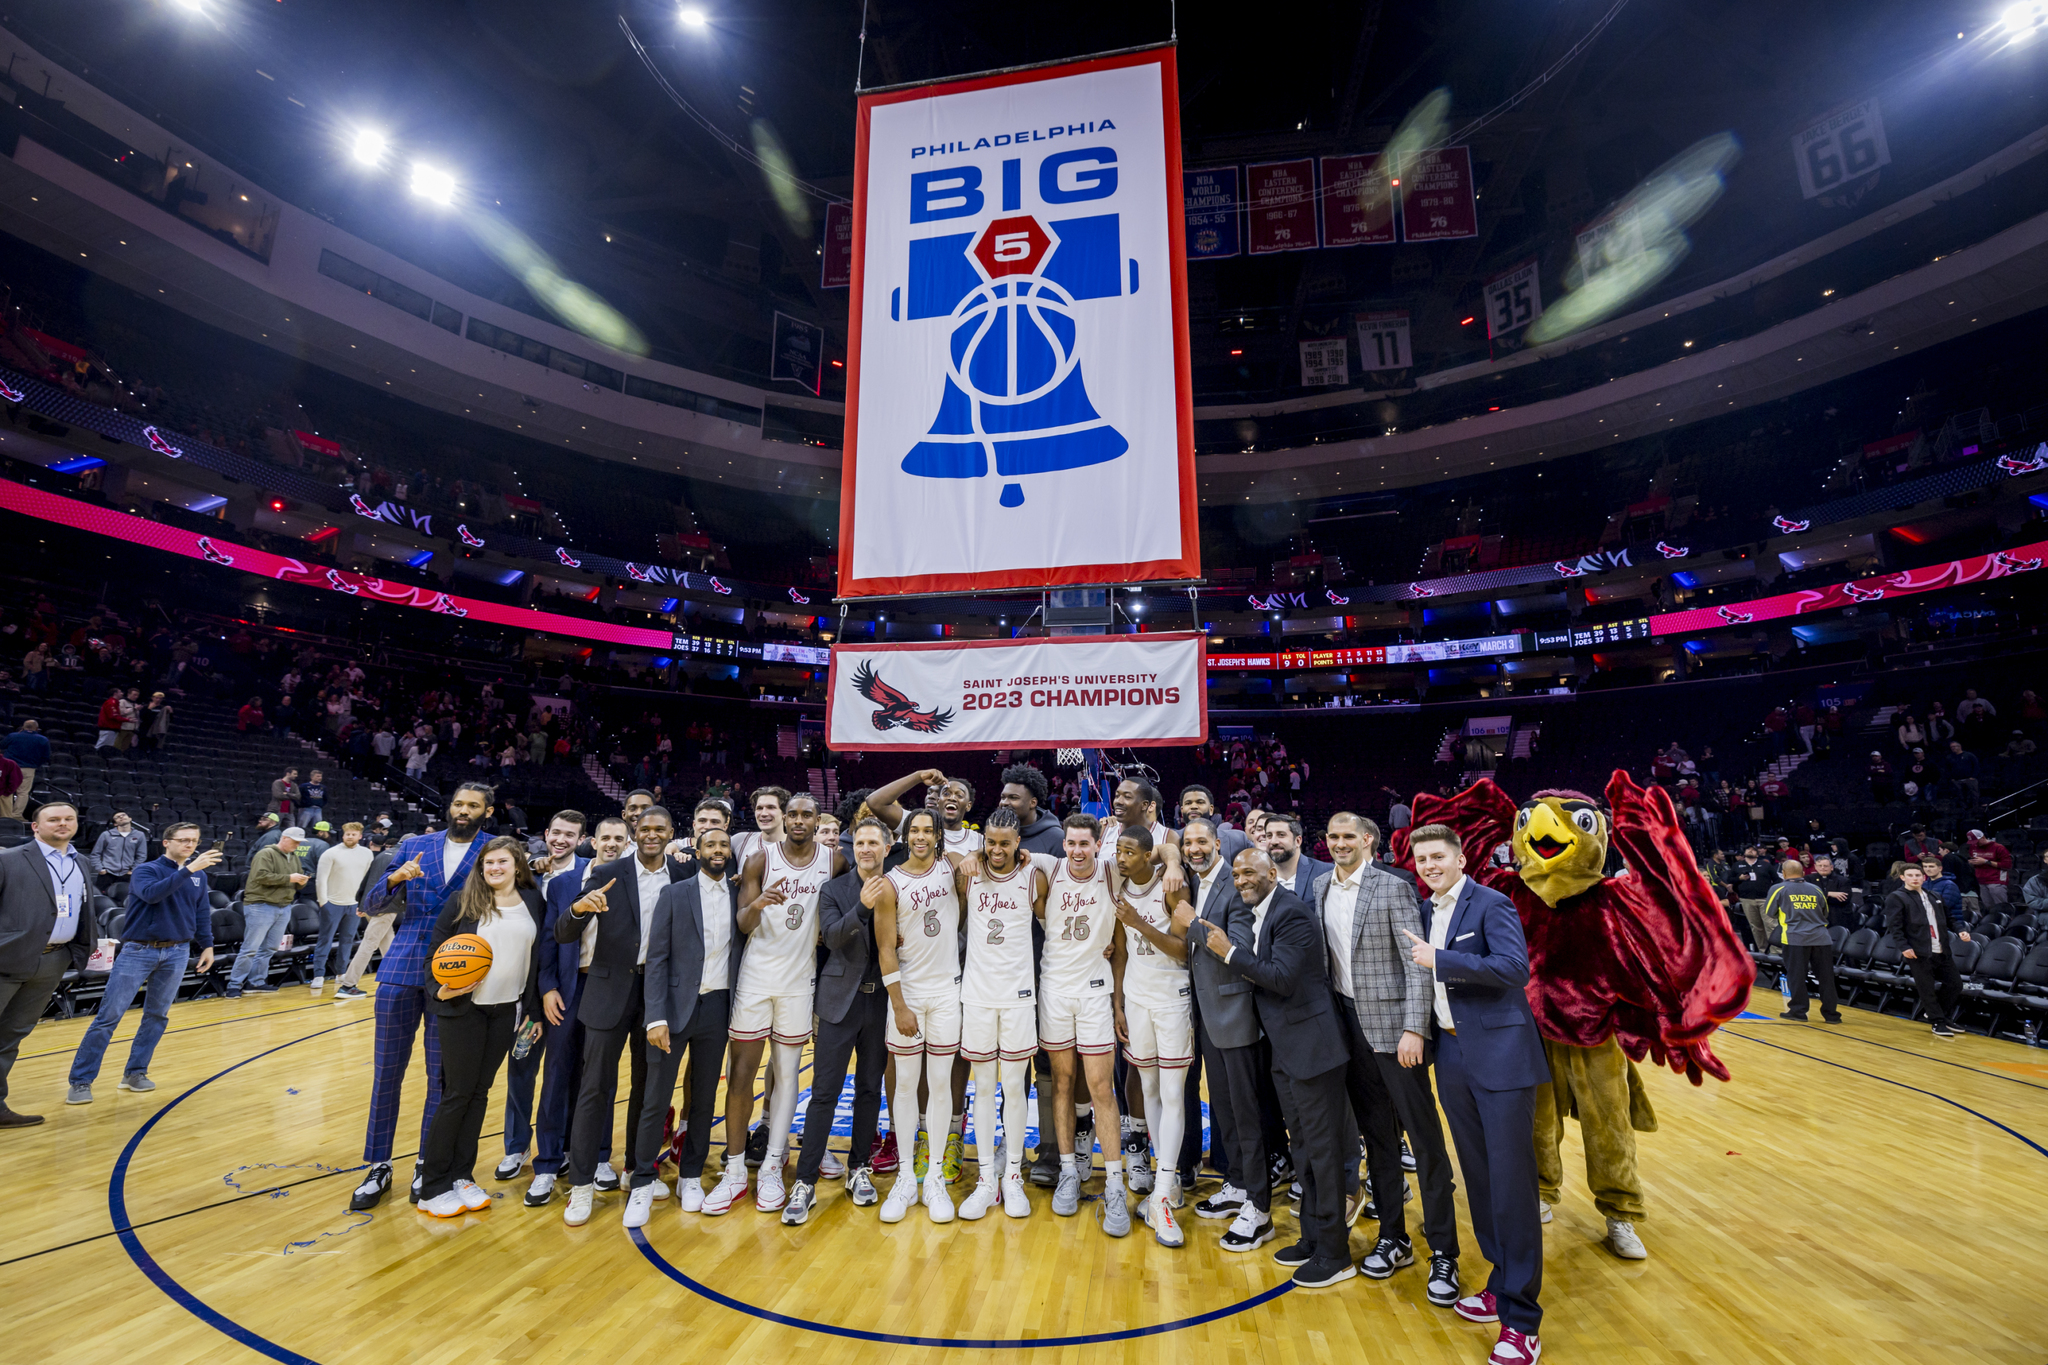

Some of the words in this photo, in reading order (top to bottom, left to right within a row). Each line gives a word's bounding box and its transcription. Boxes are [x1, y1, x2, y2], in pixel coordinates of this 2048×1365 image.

[911, 119, 1116, 159] PHILADELPHIA
[1808, 121, 1878, 188] 66
[1272, 169, 1288, 178] NBA
[1417, 163, 1452, 174] EASTERN
[1196, 175, 1214, 186] NBA
[1264, 176, 1297, 188] EASTERN
[1411, 171, 1459, 183] CONFERENCE
[909, 146, 1119, 225] BIG
[1191, 185, 1221, 196] WORLD
[1258, 185, 1304, 197] CONFERENCE
[1414, 180, 1459, 191] CHAMPIONS
[1336, 186, 1379, 198] CHAMPIONS
[1260, 194, 1303, 205] CHAMPIONS
[1351, 221, 1368, 234] 76
[1430, 216, 1448, 228] 76
[1274, 228, 1291, 241] 76
[993, 231, 1031, 262] 5
[1495, 281, 1532, 332] 35
[1372, 331, 1400, 366] 11
[1480, 640, 1508, 652] MARCH
[1508, 639, 1515, 649] 3
[1574, 638, 1593, 646] JOES
[739, 646, 752, 654] 9:53
[64, 657, 78, 667] 10
[1207, 658, 1217, 666] ST.
[1217, 658, 1245, 666] JOSEPH'S
[1247, 658, 1270, 666] HAWKS
[1297, 659, 1304, 667] 0
[963, 678, 1003, 689] SAINT
[1006, 675, 1070, 687] JOSEPH'S
[1075, 673, 1158, 685] UNIVERSITY
[962, 690, 1024, 711] 2023
[1030, 686, 1181, 708] CHAMPIONS
[1820, 697, 1842, 708] 105
[791, 878, 818, 899] Joe's
[924, 886, 948, 908] Joe's
[990, 892, 1018, 914] Joe's
[1788, 895, 1818, 903] EVENT
[1793, 902, 1818, 910] STAFF
[785, 903, 804, 930] 3
[923, 909, 941, 938] 5
[1061, 915, 1090, 941] 15
[986, 919, 1005, 945] 2
[438, 942, 477, 954] Wilson
[438, 960, 467, 970] NCAA
